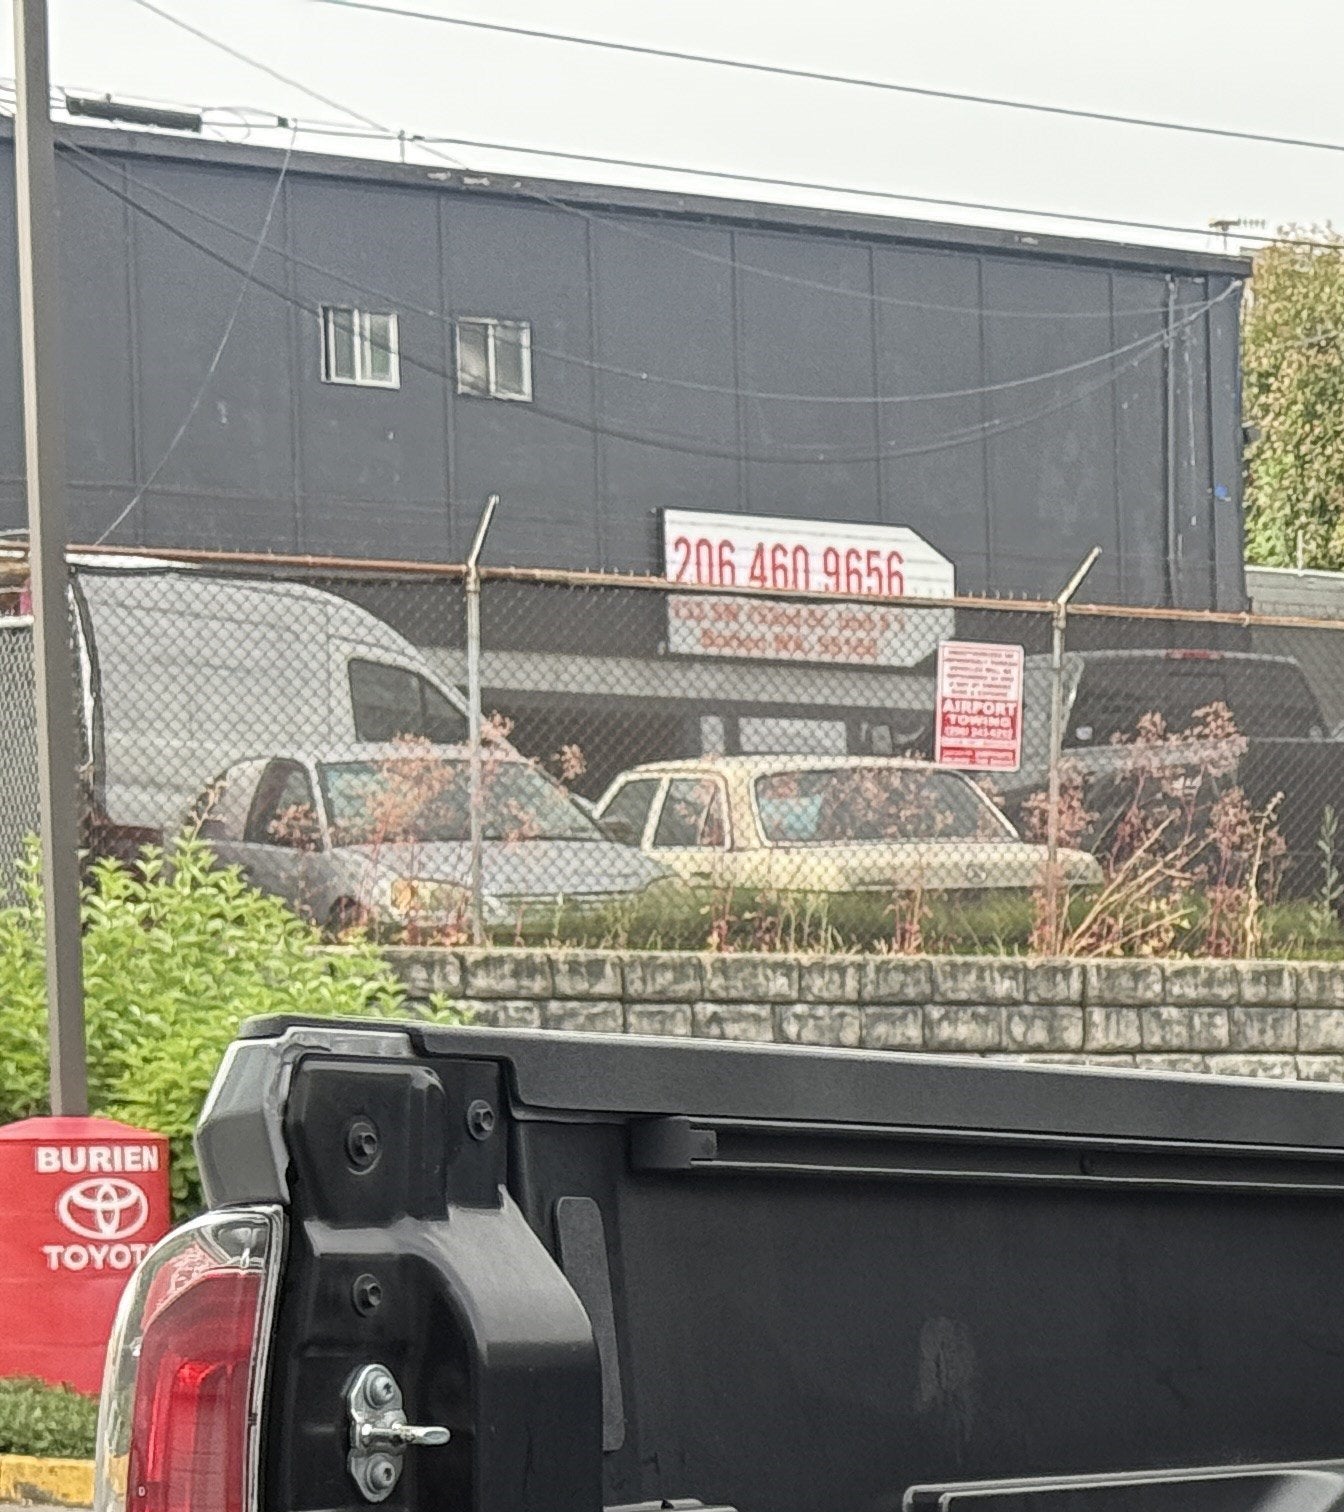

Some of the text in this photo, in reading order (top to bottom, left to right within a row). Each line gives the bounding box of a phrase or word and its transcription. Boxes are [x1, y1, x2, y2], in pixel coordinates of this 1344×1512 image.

[674, 535, 904, 597] 206 460 9656
[942, 698, 1016, 716] AIRPORT
[36, 1145, 159, 1173] BURIEN
[43, 1243, 154, 1271] TOYOT
